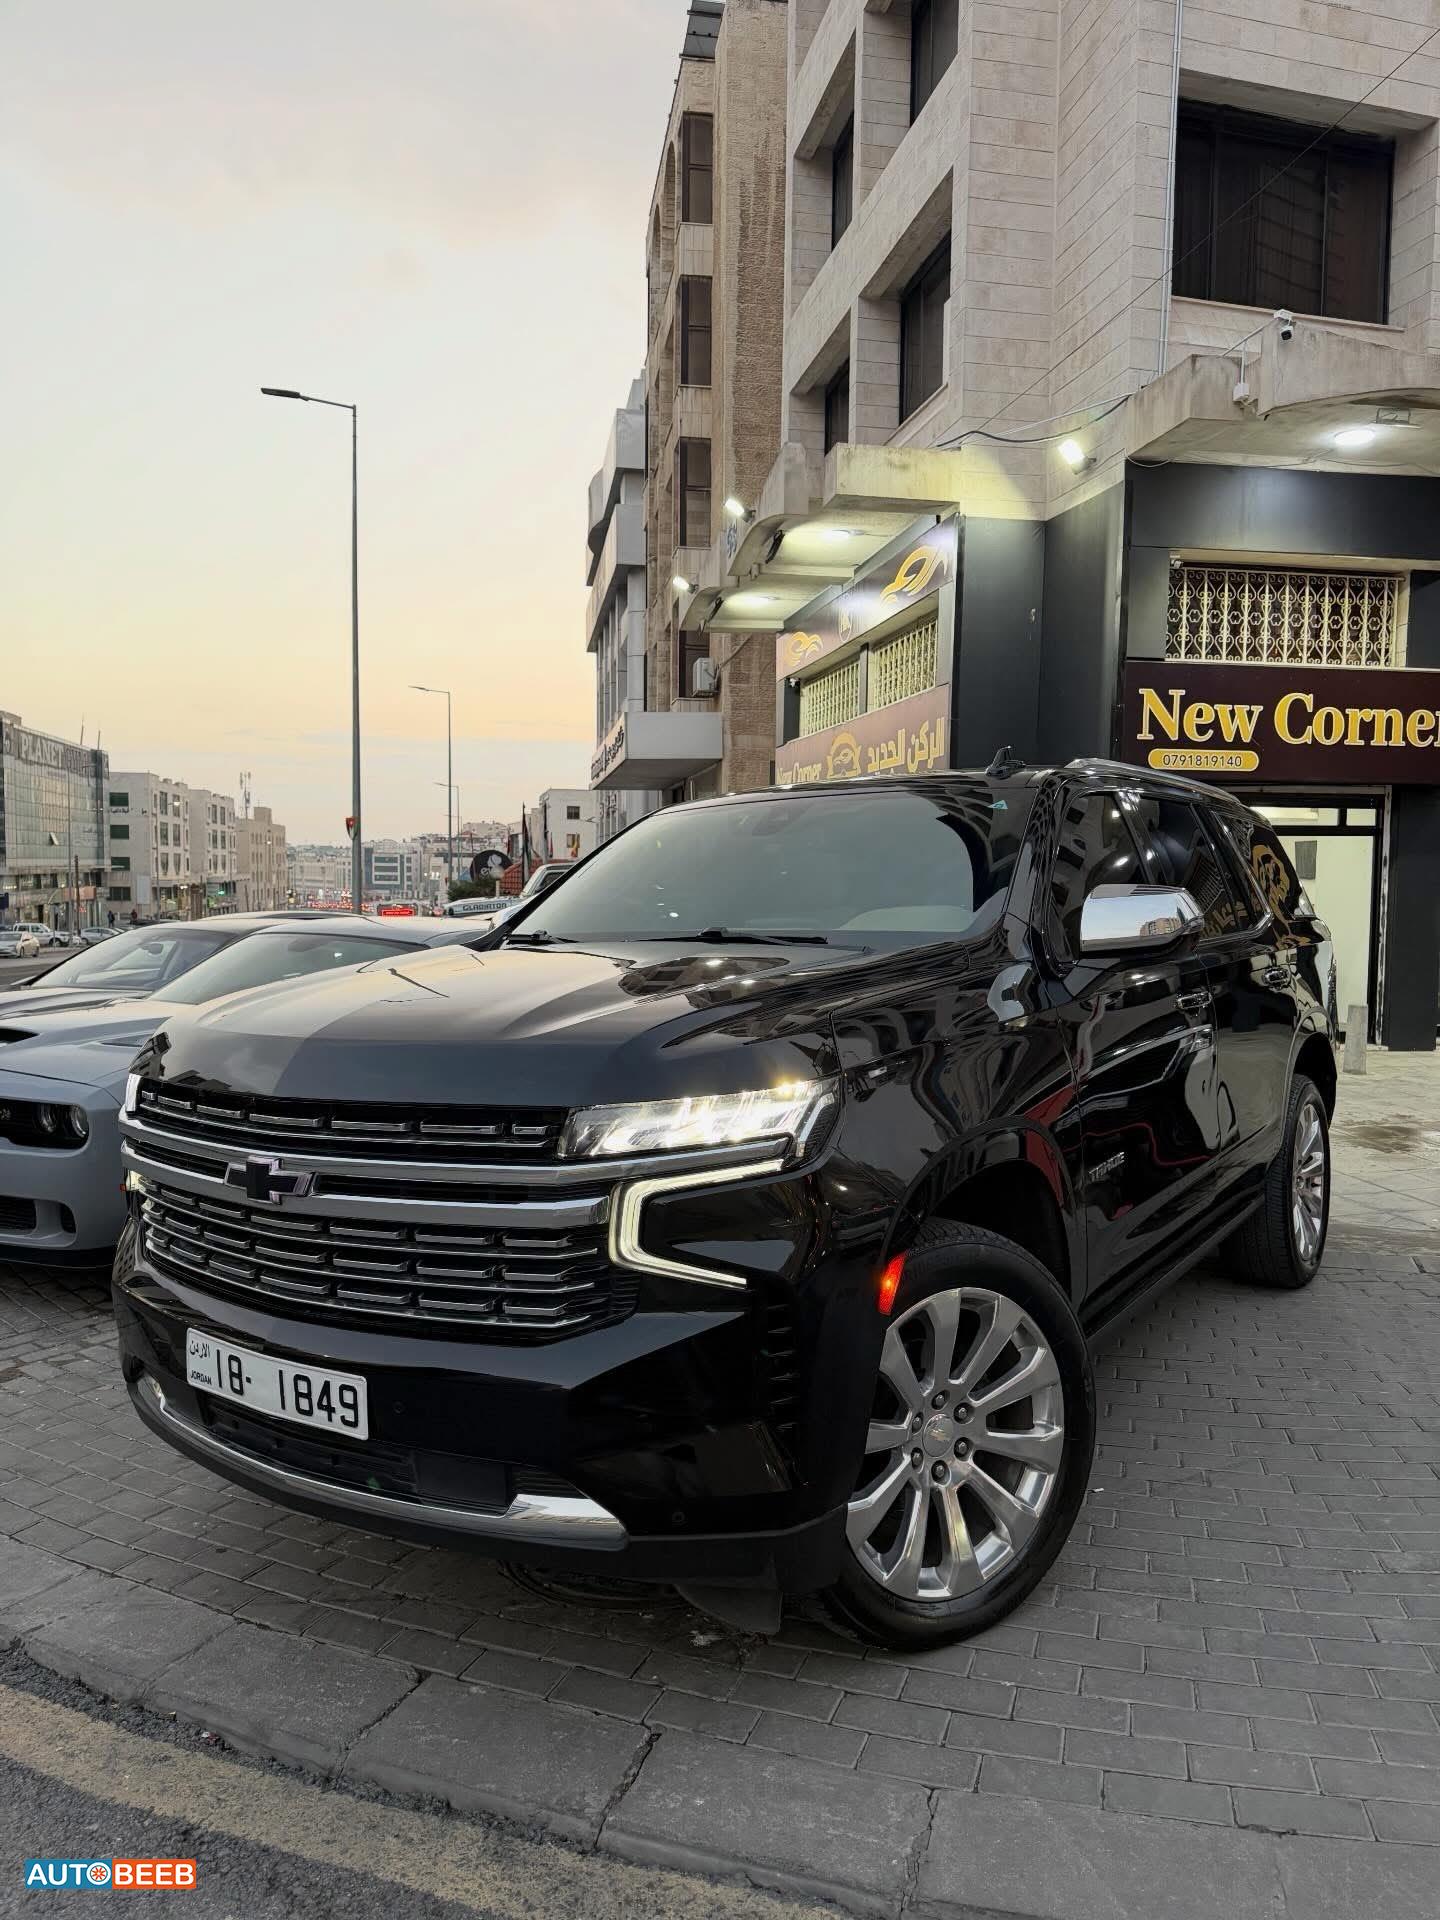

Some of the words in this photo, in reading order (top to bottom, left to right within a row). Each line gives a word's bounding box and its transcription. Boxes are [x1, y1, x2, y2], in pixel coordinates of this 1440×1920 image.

[1136, 688, 1264, 743] New
[21, 735, 64, 769] PLANET
[867, 728, 906, 775] الجديد
[907, 717, 945, 773] الركن
[1162, 753, 1243, 768] 0791819140
[462, 902, 508, 912] GLADIATOR
[190, 1370, 212, 1385] JORDAN
[278, 1369, 359, 1429] 1849
